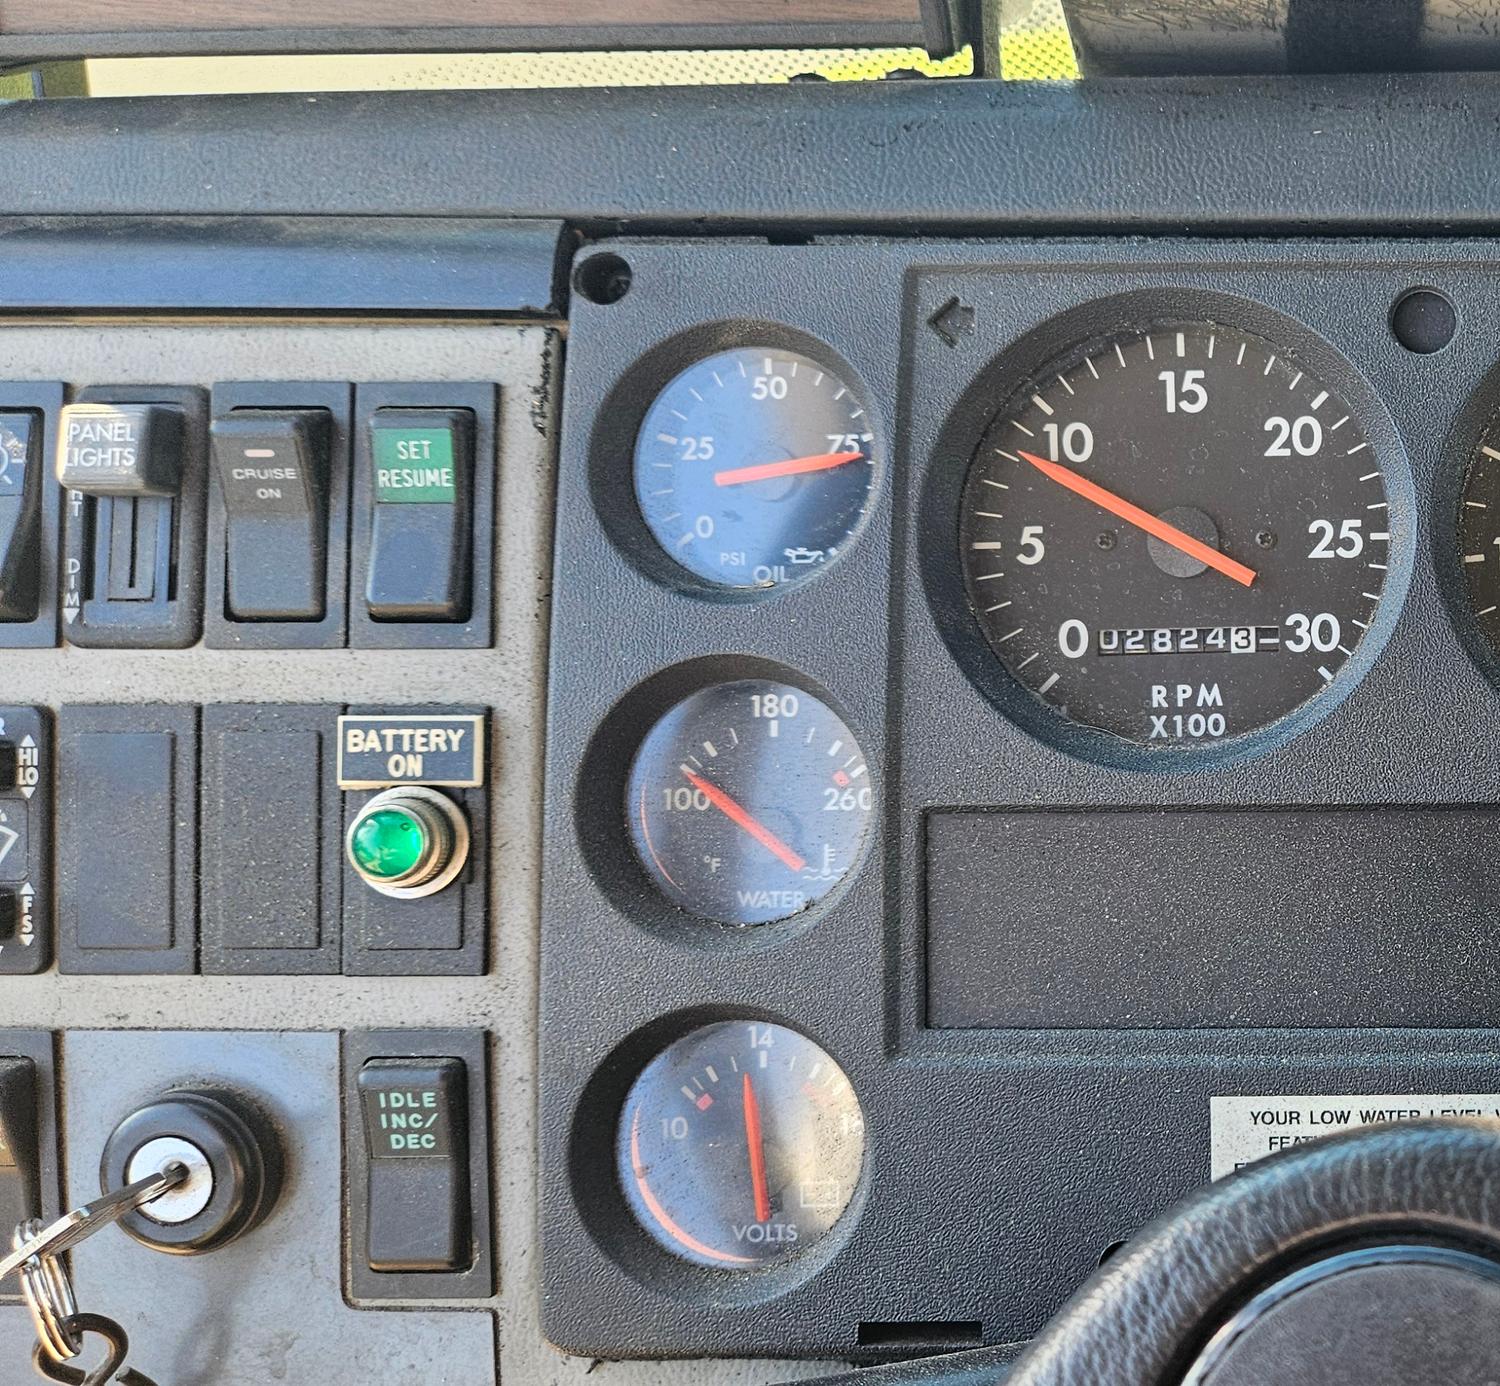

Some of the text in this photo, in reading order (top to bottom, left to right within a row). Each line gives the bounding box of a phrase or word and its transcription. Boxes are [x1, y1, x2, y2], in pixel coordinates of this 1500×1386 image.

[752, 376, 788, 399] 50
[1158, 370, 1208, 413] 15
[68, 423, 135, 442] PANEL
[1043, 422, 1093, 463] 10
[1264, 416, 1322, 457] 20
[397, 440, 431, 459] SET
[680, 437, 714, 461] 25
[826, 434, 860, 454] 75
[65, 448, 136, 467] LIGHTS
[232, 468, 297, 480] CRUISE
[378, 468, 453, 488] RESUME
[256, 488, 281, 499] ON
[695, 517, 714, 538] 0
[1016, 526, 1045, 565] 5
[1308, 520, 1363, 559] 25
[720, 552, 745, 566] PSI
[753, 566, 789, 583] OIL
[1058, 620, 1088, 659] 0
[1284, 614, 1341, 652] 30
[752, 694, 799, 718] 180
[1152, 684, 1223, 707] RPM
[1150, 713, 1226, 738] X100
[347, 729, 465, 752] BATTERY
[18, 748, 38, 766] HI
[388, 754, 423, 777] ON
[663, 787, 711, 811] 100
[737, 891, 805, 908] WATER
[747, 1027, 775, 1048] 14
[379, 1092, 437, 1108] IDLE
[381, 1113, 438, 1128] INC/
[661, 1117, 688, 1139] 10
[1250, 1111, 1301, 1125] YOUR
[1310, 1110, 1351, 1124] LOW
[390, 1133, 436, 1149] DEC
[732, 1224, 798, 1242] VOLTS
